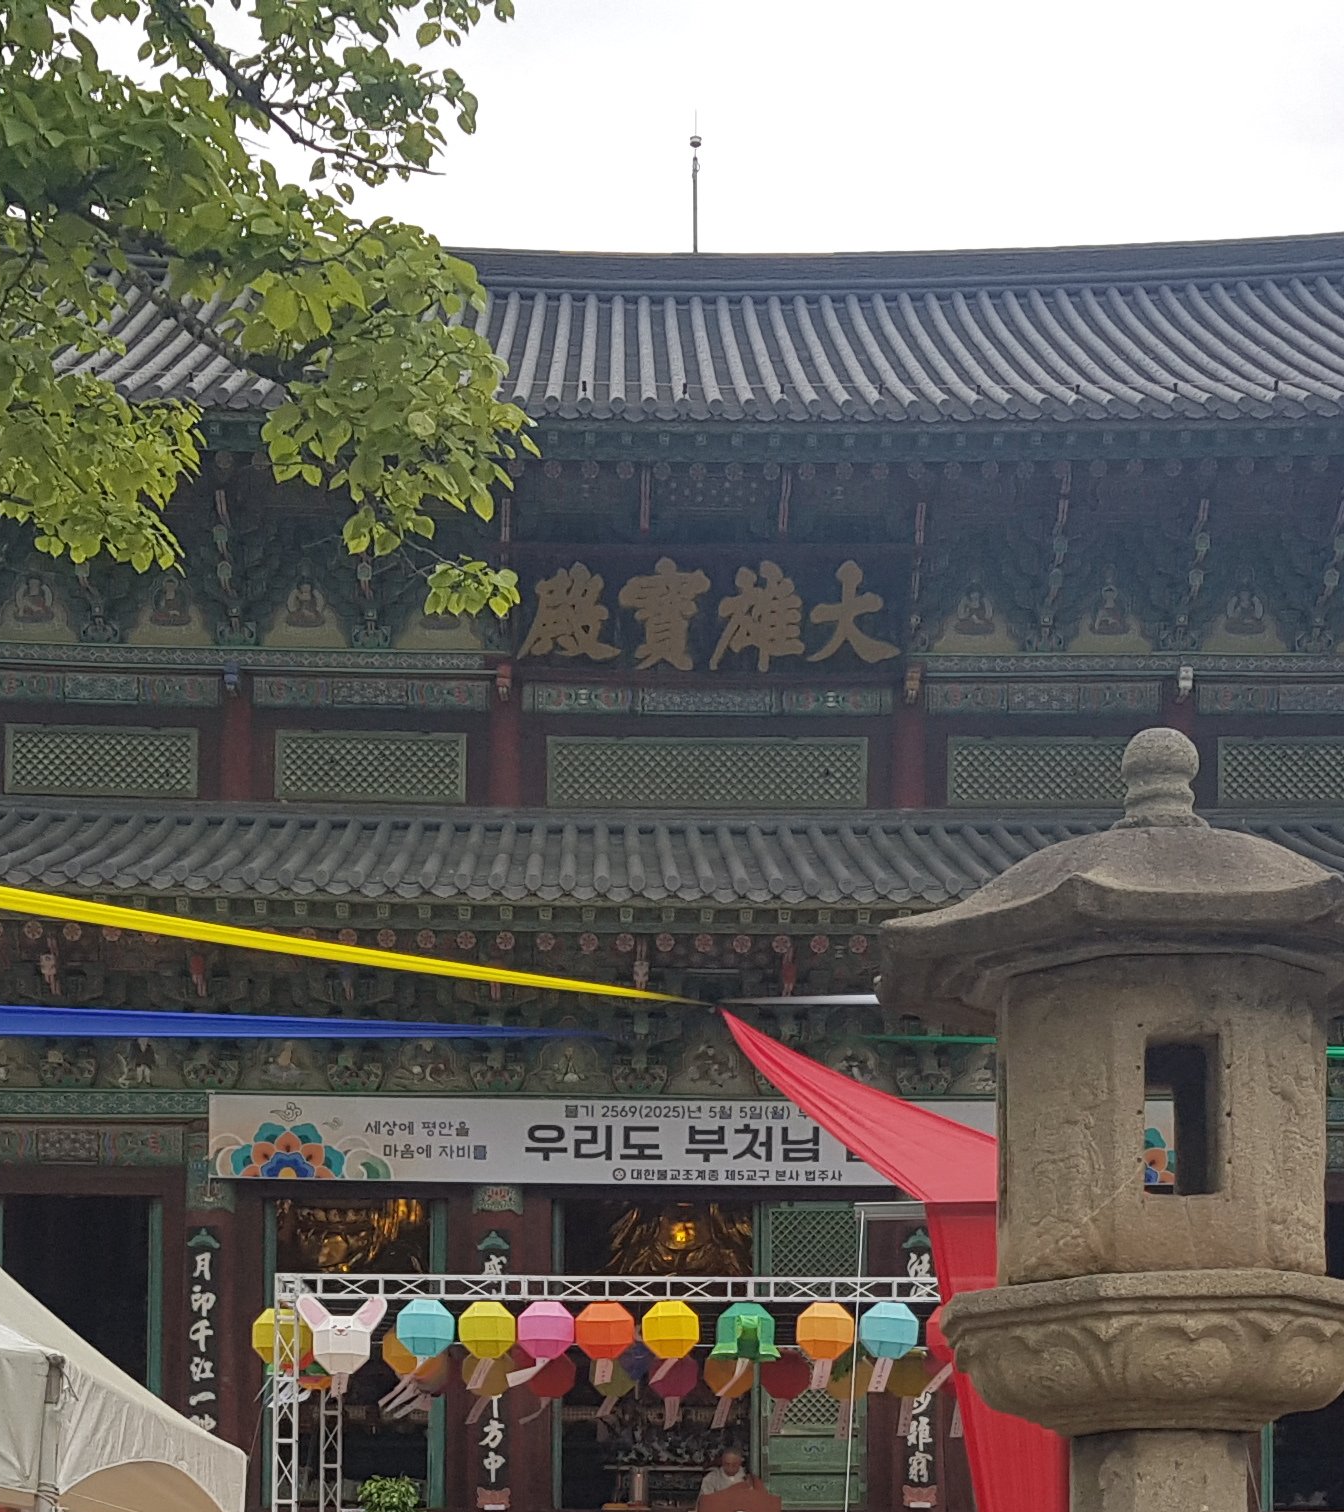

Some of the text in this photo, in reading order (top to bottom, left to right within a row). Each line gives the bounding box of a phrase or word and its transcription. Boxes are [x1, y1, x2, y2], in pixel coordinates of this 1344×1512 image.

[601, 1104, 702, 1119] 2569(2025)년
[708, 1105, 733, 1120] 5월
[739, 1105, 791, 1120] 5일(월)
[364, 1120, 470, 1137] 세상에 평안을
[383, 1143, 433, 1160] 마음에
[524, 1124, 663, 1162] 우리도
[684, 1123, 820, 1163] 부처님
[630, 1169, 843, 1182] 대한불교조계종 제5교구 본사 법주사
